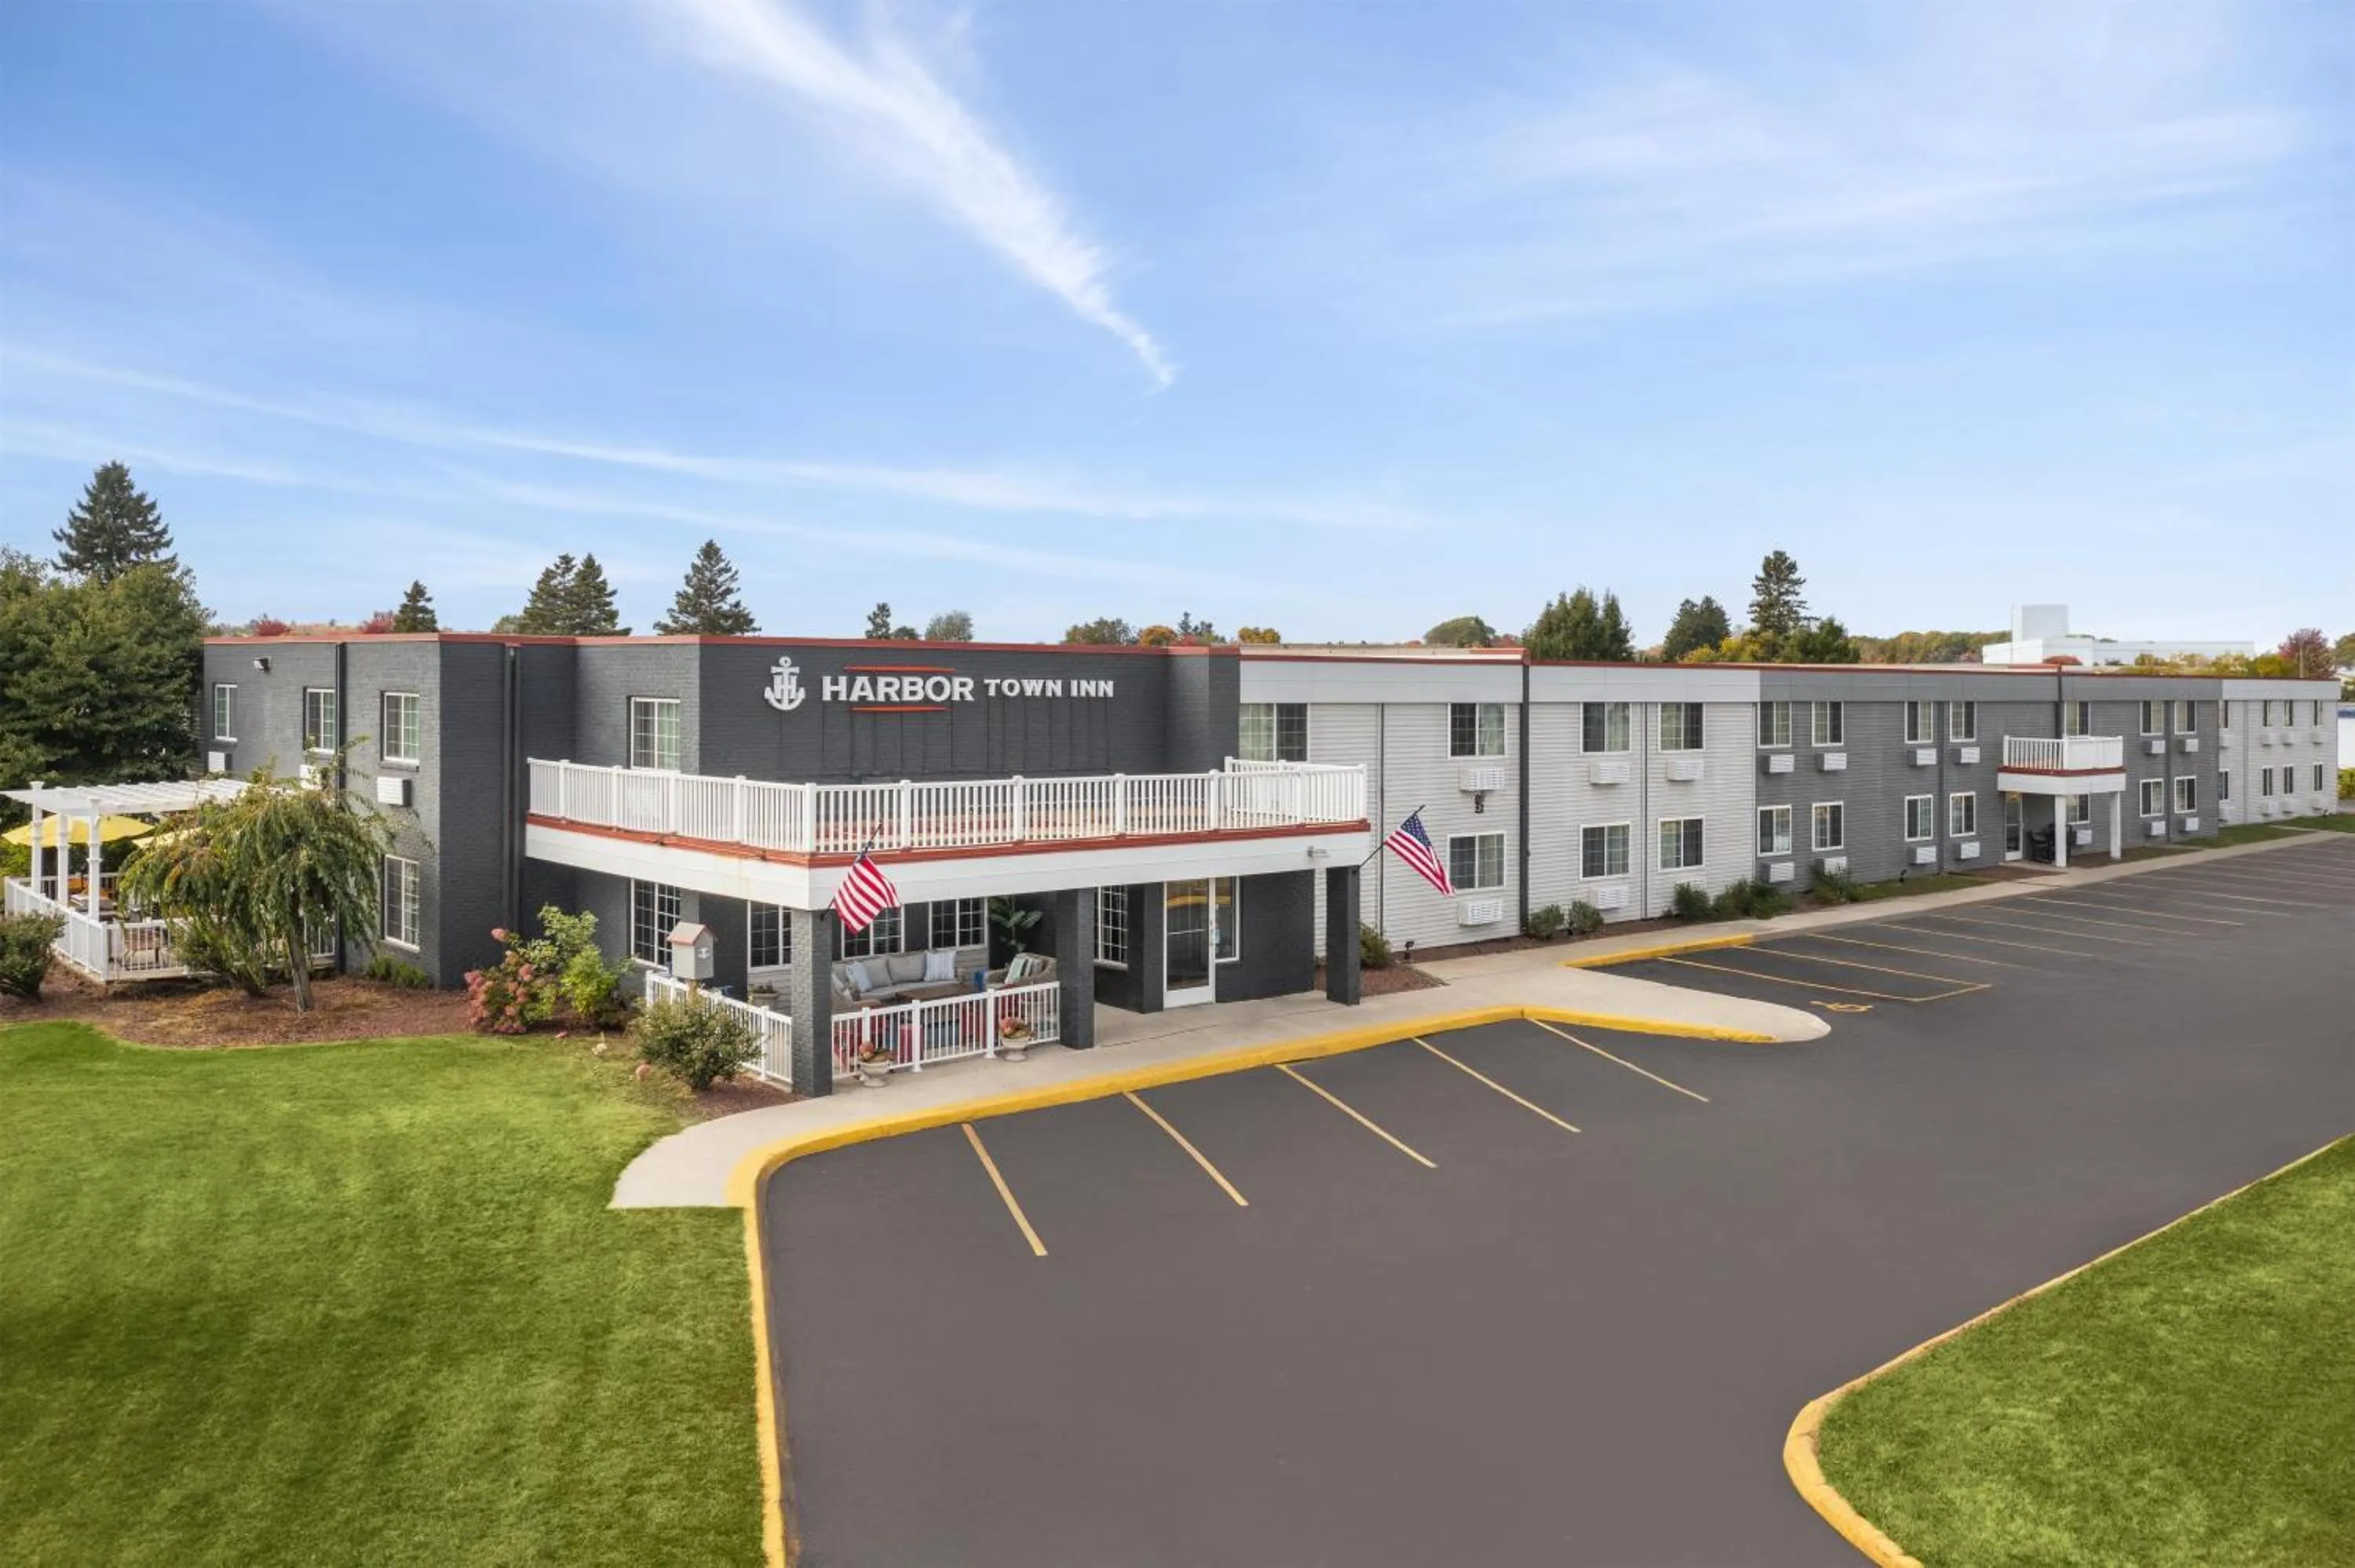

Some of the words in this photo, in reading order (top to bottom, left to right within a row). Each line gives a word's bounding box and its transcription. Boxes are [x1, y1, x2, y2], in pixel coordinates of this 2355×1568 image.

[822, 675, 975, 702] HARBOR
[984, 678, 1062, 698] TOWN
[1070, 679, 1115, 698] INN
